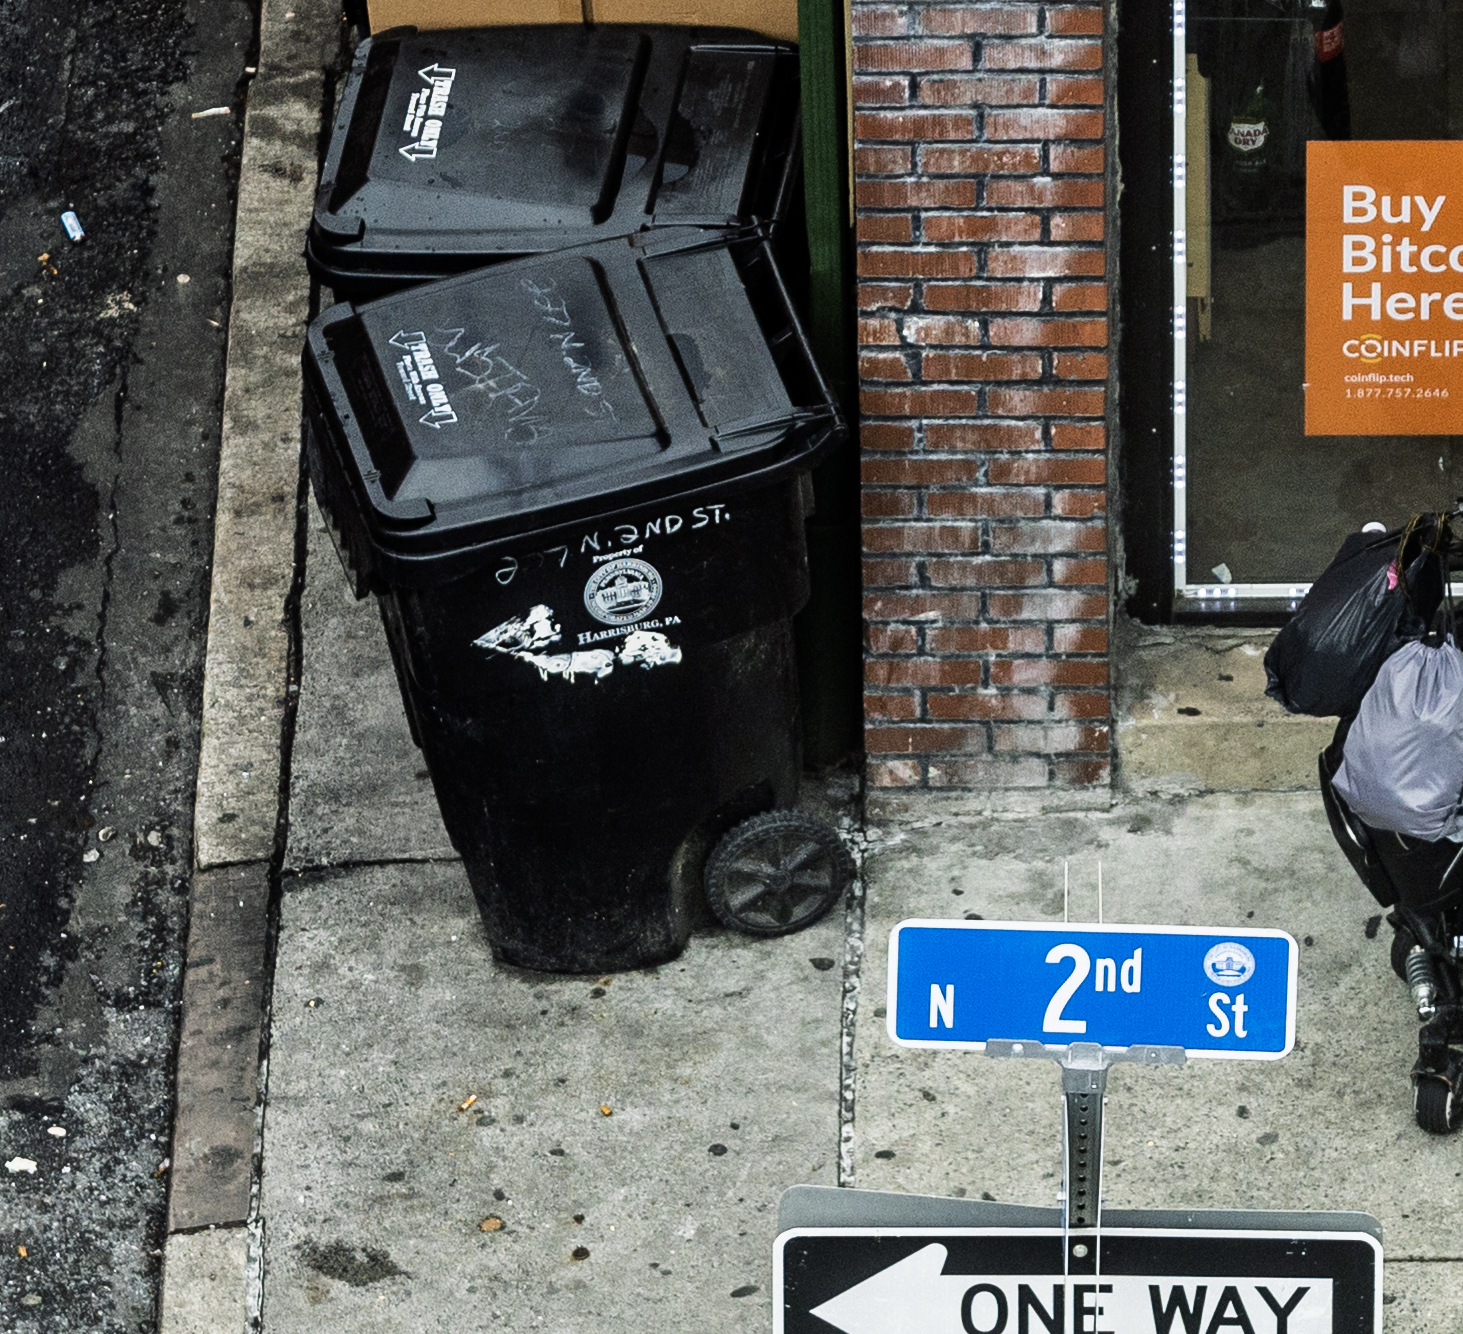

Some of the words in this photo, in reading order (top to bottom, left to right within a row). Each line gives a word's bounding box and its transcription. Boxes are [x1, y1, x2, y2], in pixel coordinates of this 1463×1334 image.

[427, 80, 452, 116] TRASH
[420, 119, 443, 148] ONLY
[1234, 137, 1258, 147] DRY
[1342, 184, 1446, 233] Buy
[411, 343, 440, 380] TRASH
[427, 383, 452, 413] ONLY
[1344, 372, 1414, 384] coinflip.tech
[1345, 388, 1449, 399] 1.877.757.2646
[580, 530, 612, 553] N.
[614, 513, 684, 544] 2ND
[691, 503, 731, 530] ST.
[592, 545, 633, 563] Property
[633, 543, 644, 554] of
[666, 614, 682, 626] PA
[930, 984, 954, 1028] N
[1043, 944, 1142, 1033] 2nd
[1206, 991, 1248, 1039] St
